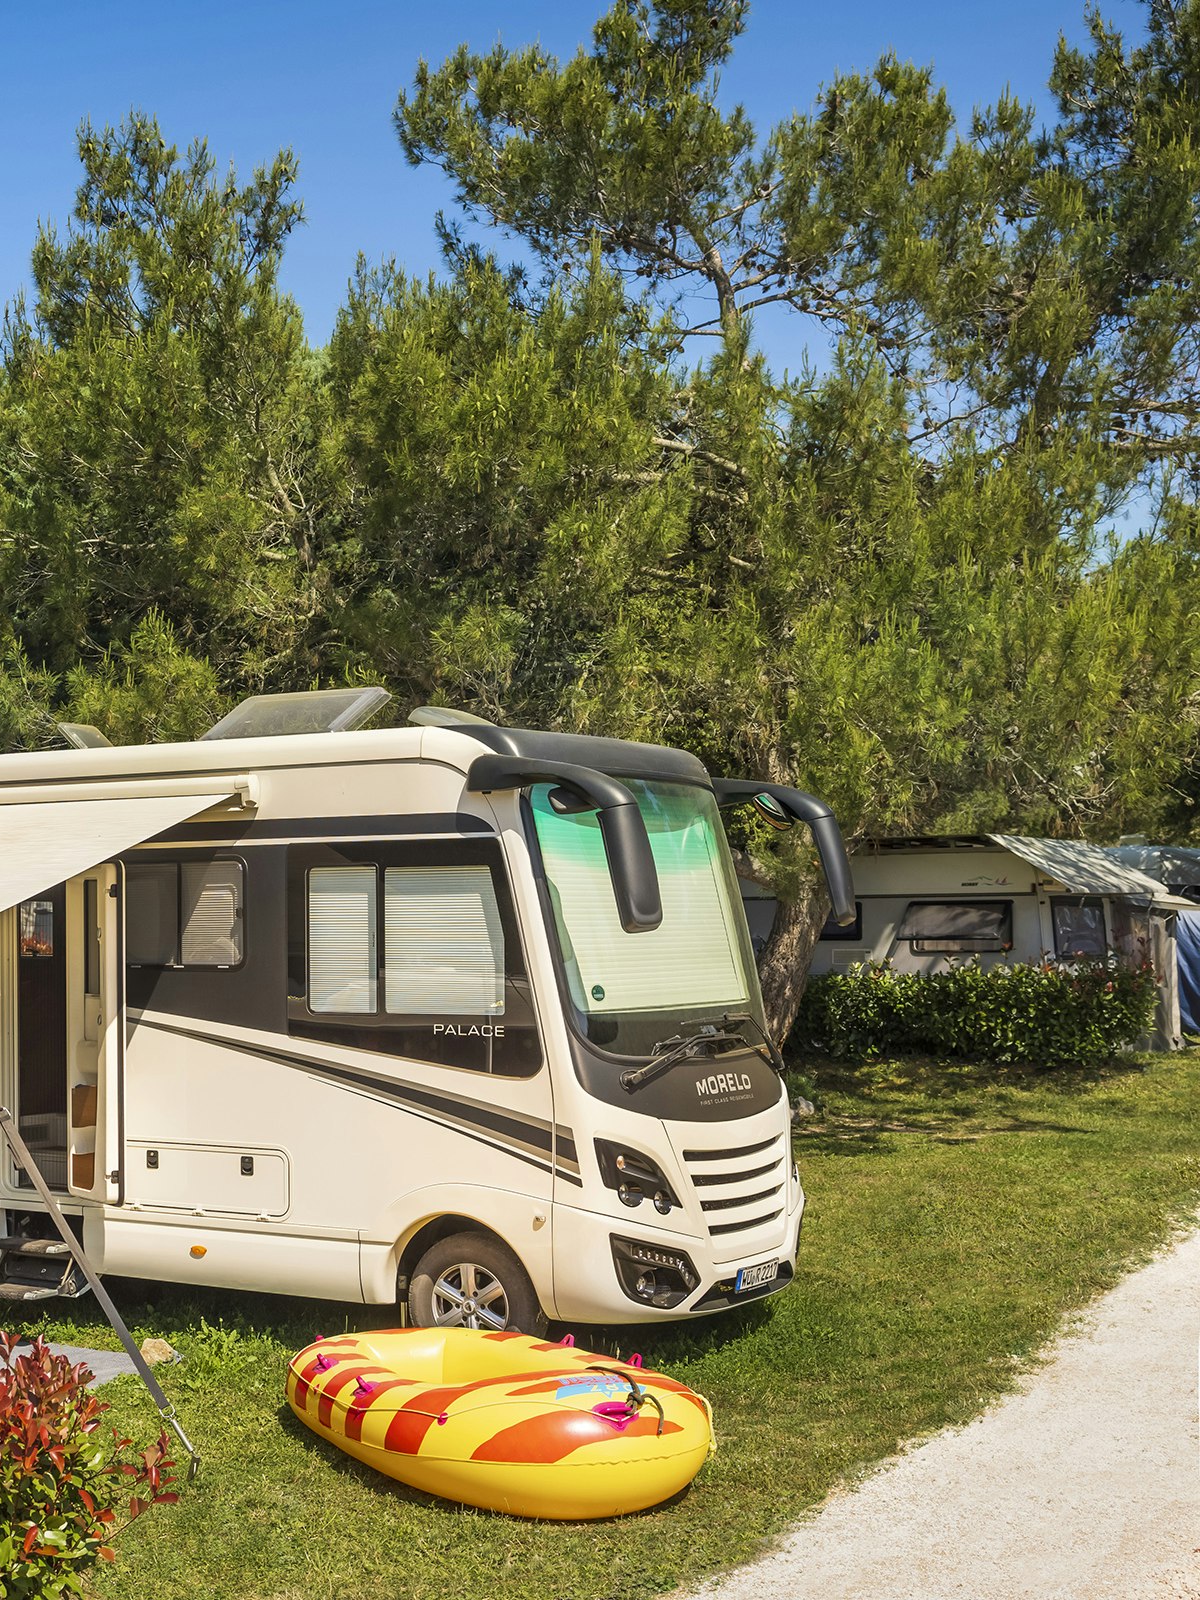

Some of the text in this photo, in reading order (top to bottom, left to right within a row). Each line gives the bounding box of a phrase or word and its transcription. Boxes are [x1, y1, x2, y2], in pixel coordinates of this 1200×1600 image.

[433, 1023, 505, 1037] PALACE
[695, 1073, 752, 1096] MORELO
[714, 1097, 729, 1105] CLASS
